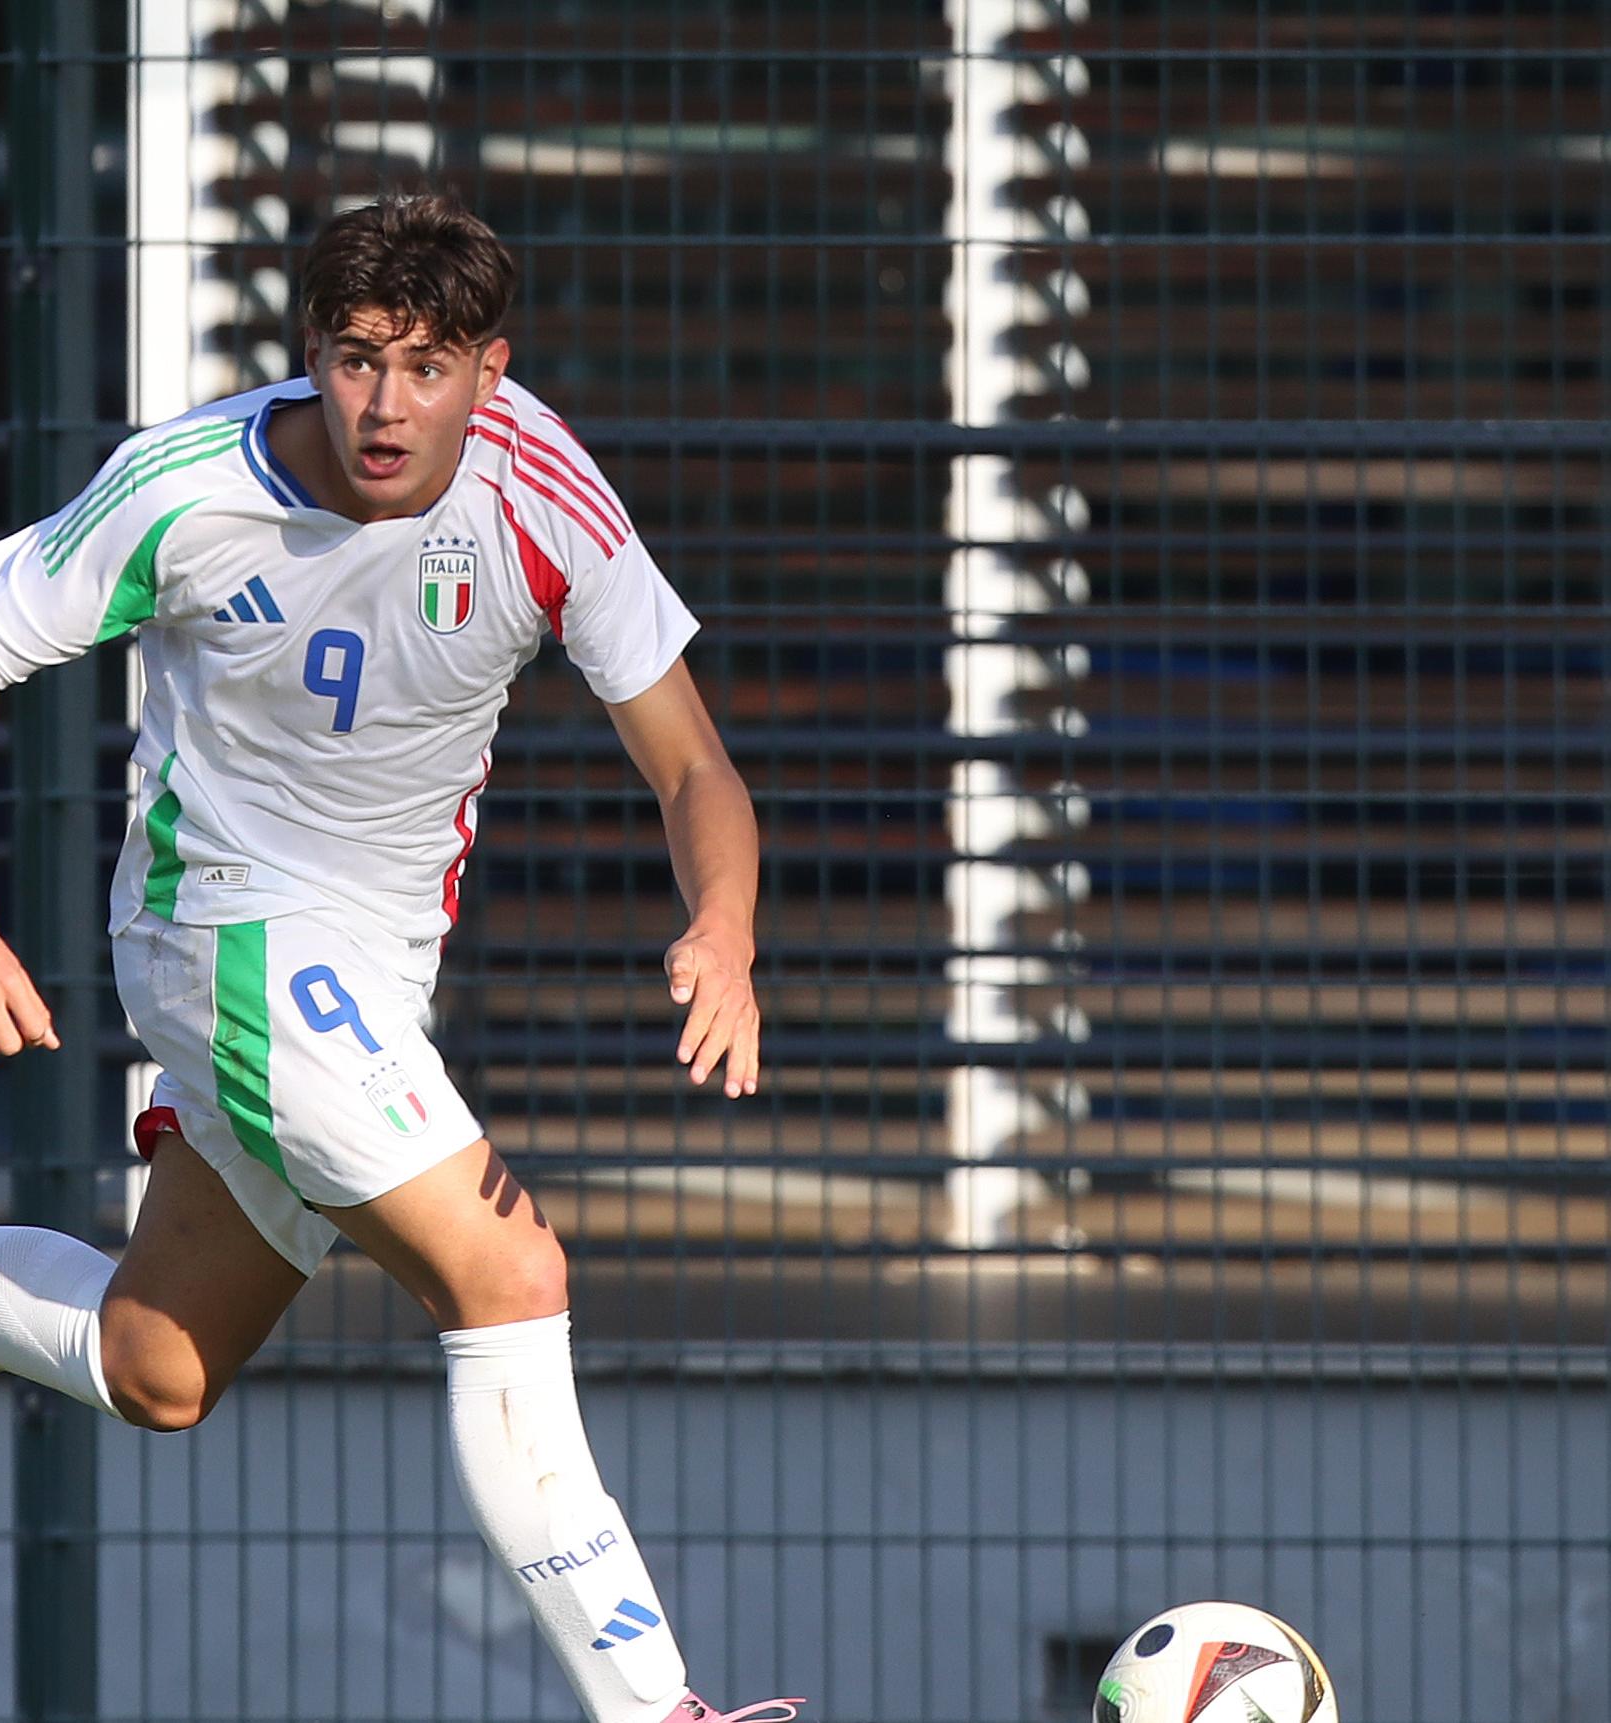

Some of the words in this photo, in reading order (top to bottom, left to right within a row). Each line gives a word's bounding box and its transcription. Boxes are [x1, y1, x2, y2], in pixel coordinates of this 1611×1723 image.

[424, 559, 471, 574] ITALIA
[303, 628, 365, 733] 9
[289, 964, 384, 1055] 9
[516, 1529, 619, 1584] ITALIA
